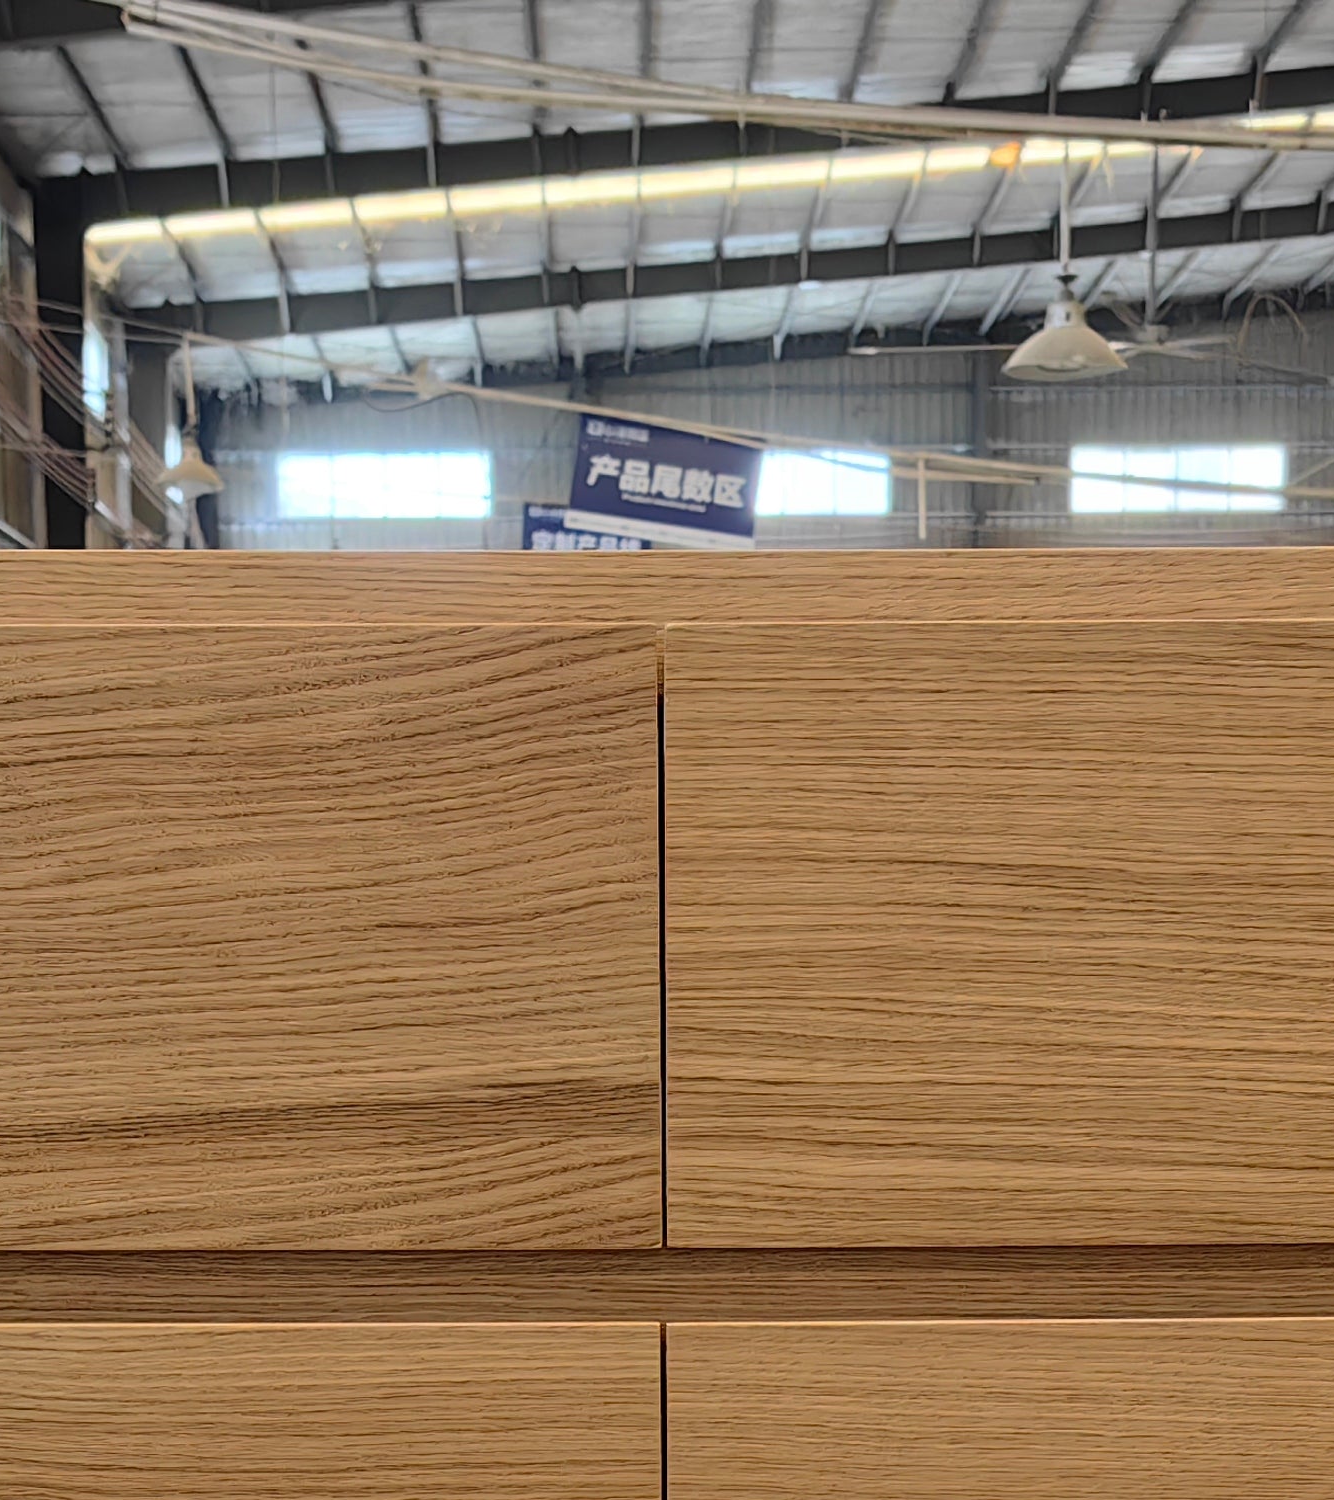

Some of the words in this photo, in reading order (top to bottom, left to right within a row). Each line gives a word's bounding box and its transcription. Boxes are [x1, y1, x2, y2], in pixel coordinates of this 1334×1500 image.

[586, 453, 747, 508] 产品尾数区
